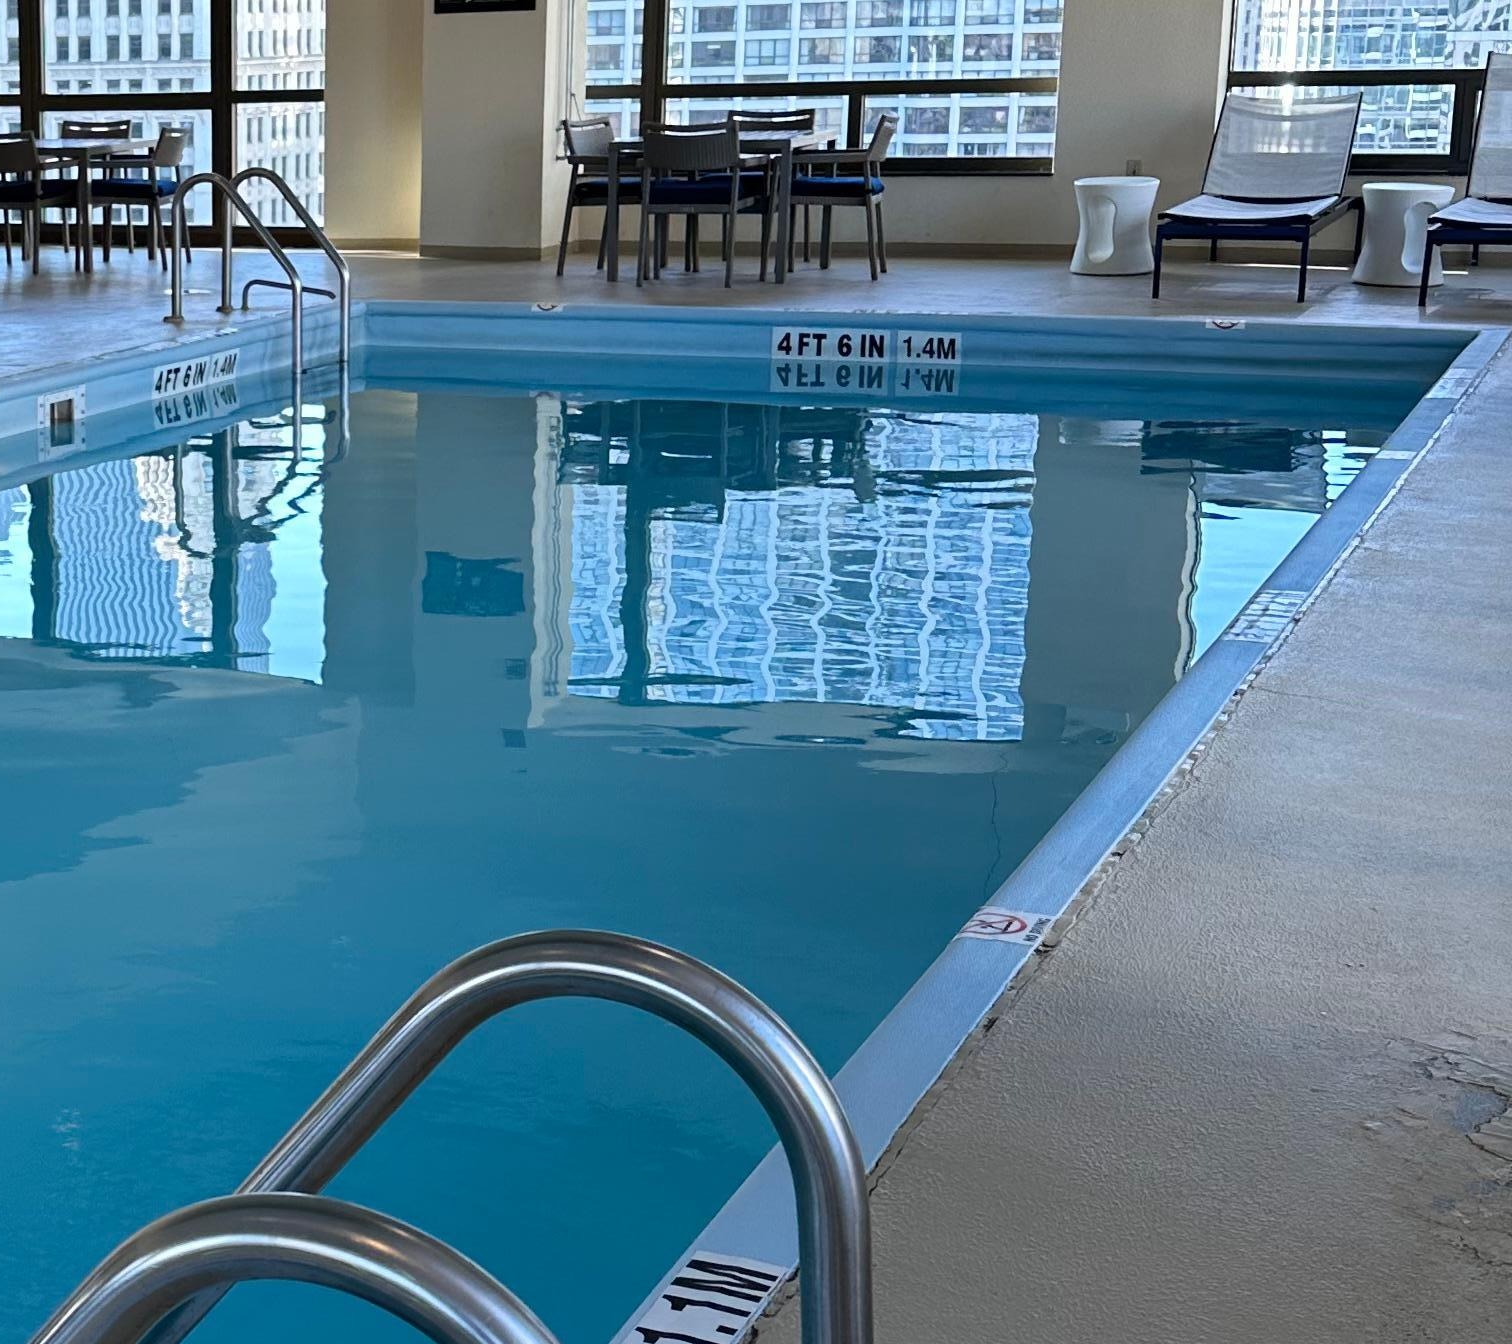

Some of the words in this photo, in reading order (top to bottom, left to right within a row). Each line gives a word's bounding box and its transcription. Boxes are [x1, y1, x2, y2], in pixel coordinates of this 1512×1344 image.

[777, 332, 792, 355] 4
[797, 332, 827, 357] FT
[837, 334, 852, 357] 6
[860, 334, 885, 358] IN
[902, 336, 957, 360] 1.4M
[183, 365, 192, 387] 6
[192, 361, 207, 386] IN
[212, 353, 238, 378] 1.4M
